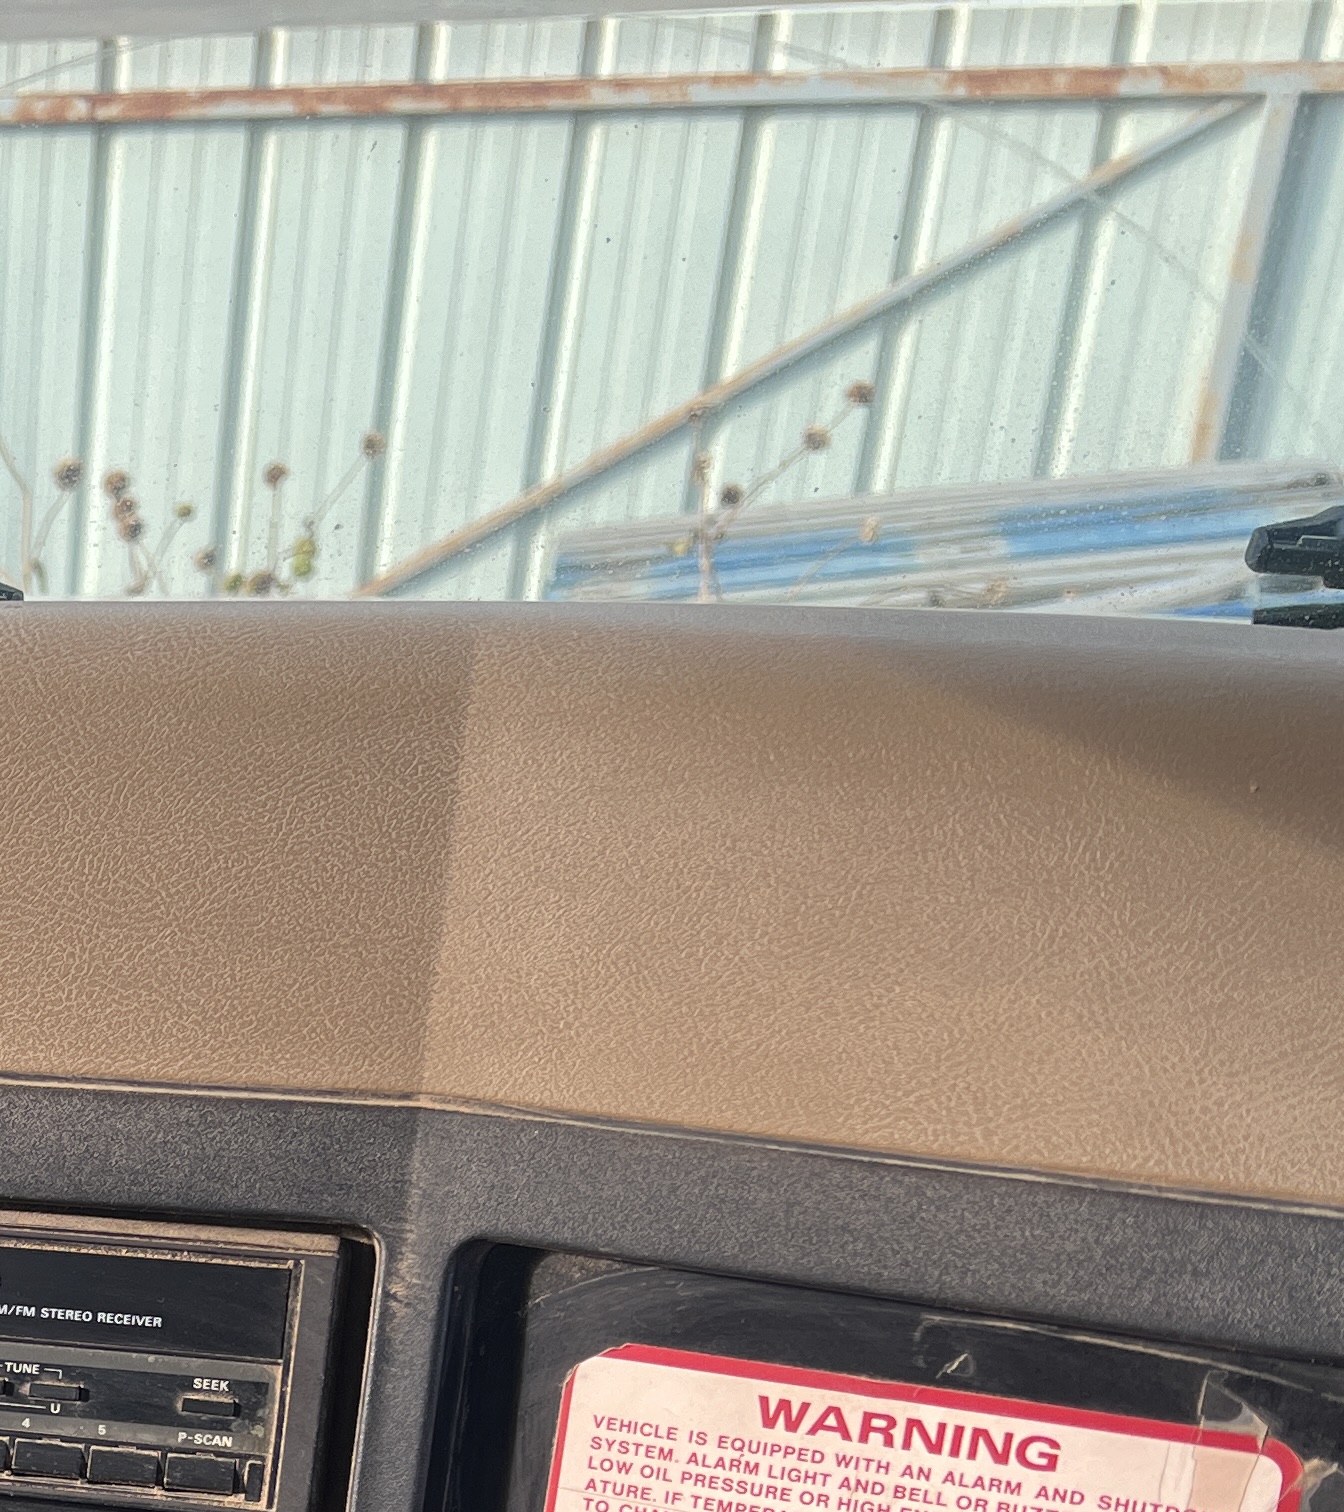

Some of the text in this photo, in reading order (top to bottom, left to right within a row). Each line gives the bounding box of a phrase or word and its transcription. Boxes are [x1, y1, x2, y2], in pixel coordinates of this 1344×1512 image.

[40, 1307, 92, 1322] STEREO
[97, 1312, 162, 1327] RECEIVER
[1, 1361, 40, 1375] TUNE
[192, 1377, 229, 1392] SEEK
[50, 1403, 61, 1414] U
[21, 1418, 31, 1430] 4
[97, 1424, 106, 1435] 5
[177, 1431, 233, 1447] P-SCAN
[758, 1394, 1061, 1472] WARNING
